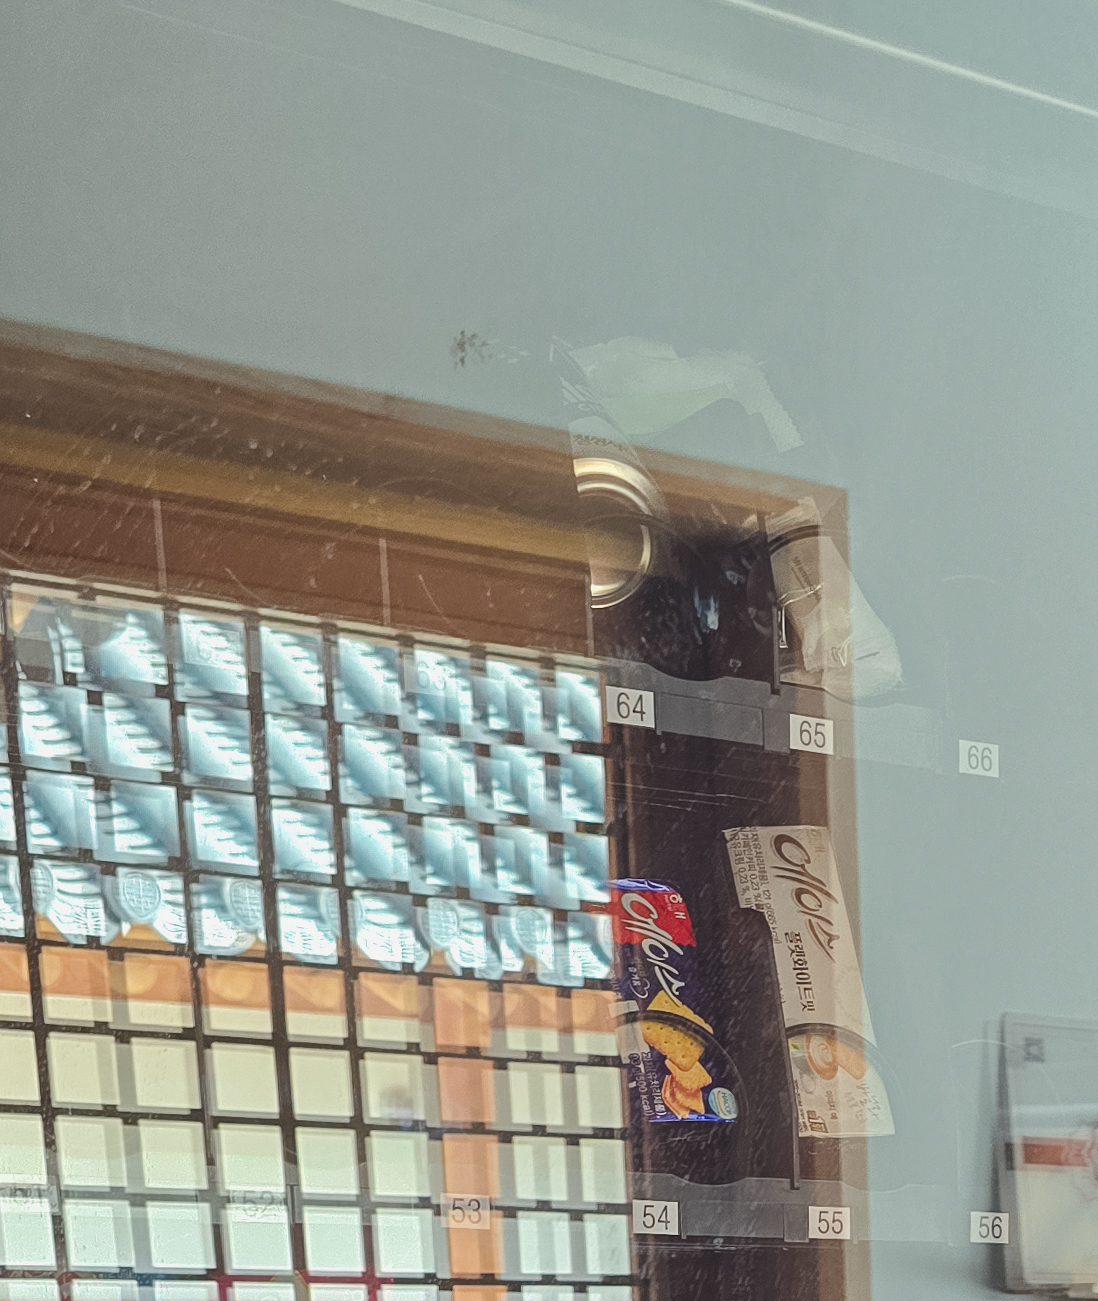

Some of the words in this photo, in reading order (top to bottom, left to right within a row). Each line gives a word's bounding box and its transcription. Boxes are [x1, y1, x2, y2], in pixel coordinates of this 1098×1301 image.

[616, 692, 646, 722] 64
[799, 720, 826, 748] 65
[967, 745, 993, 771] 66
[773, 833, 838, 963] 에이스
[620, 892, 686, 1008] 에이스
[451, 1198, 482, 1225] 53
[641, 1204, 671, 1230] 54
[817, 1210, 845, 1233] 55
[978, 1216, 1003, 1239] 56
